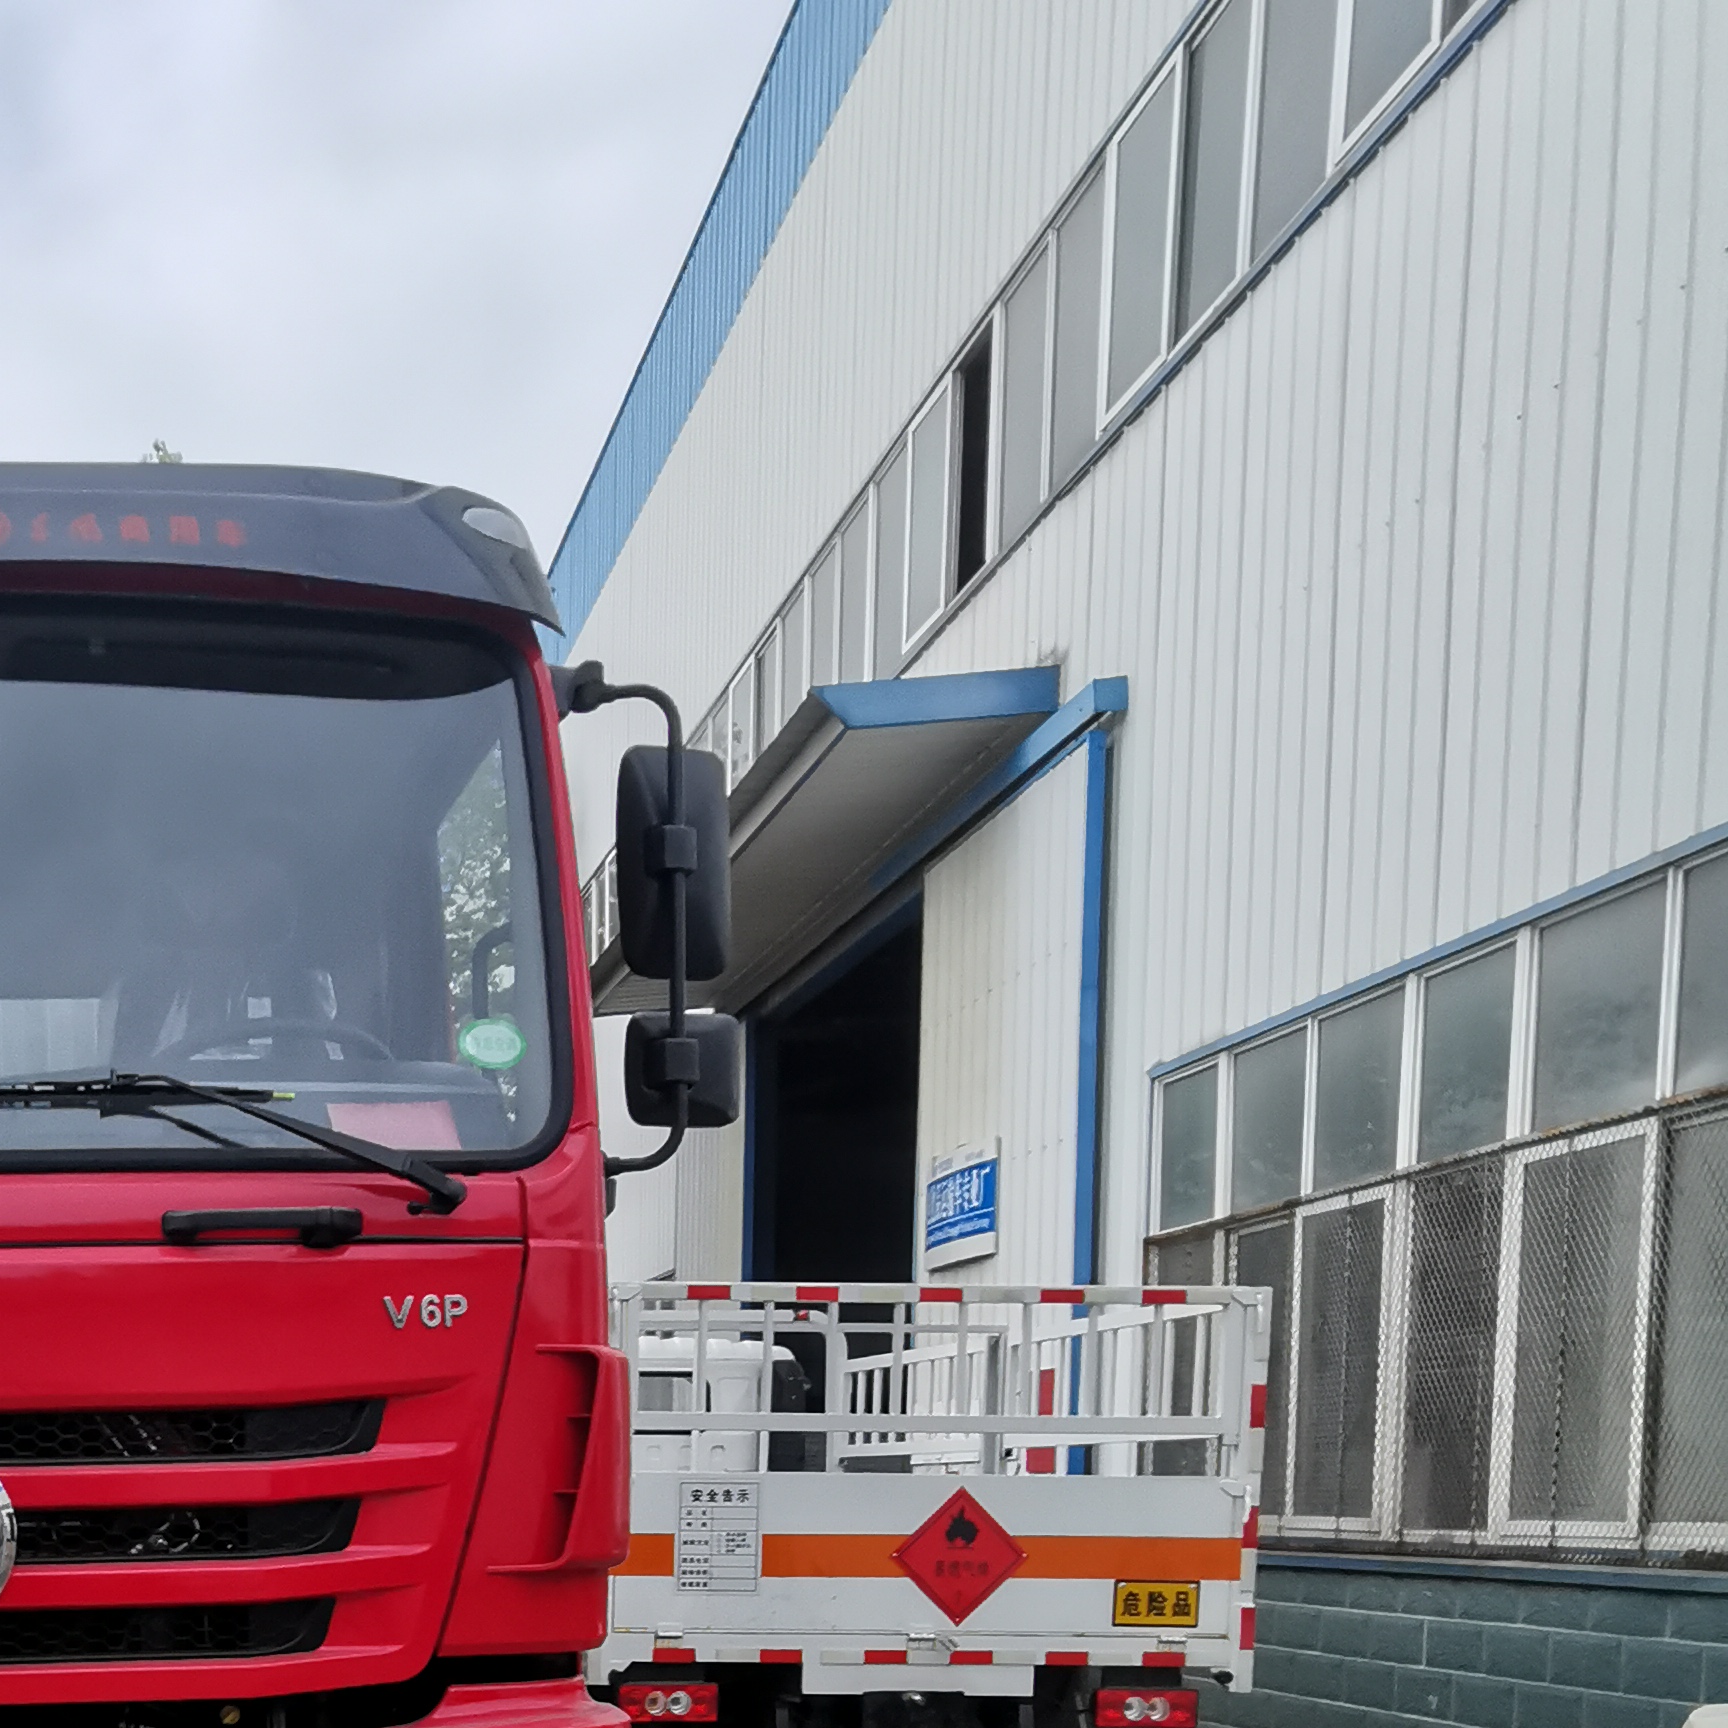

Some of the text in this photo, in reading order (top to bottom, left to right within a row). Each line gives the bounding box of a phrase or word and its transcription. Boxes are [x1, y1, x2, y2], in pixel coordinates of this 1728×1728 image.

[382, 1293, 469, 1329] V6P
[690, 1488, 751, 1503] 安全告示
[1120, 1590, 1192, 1618] 危险品
